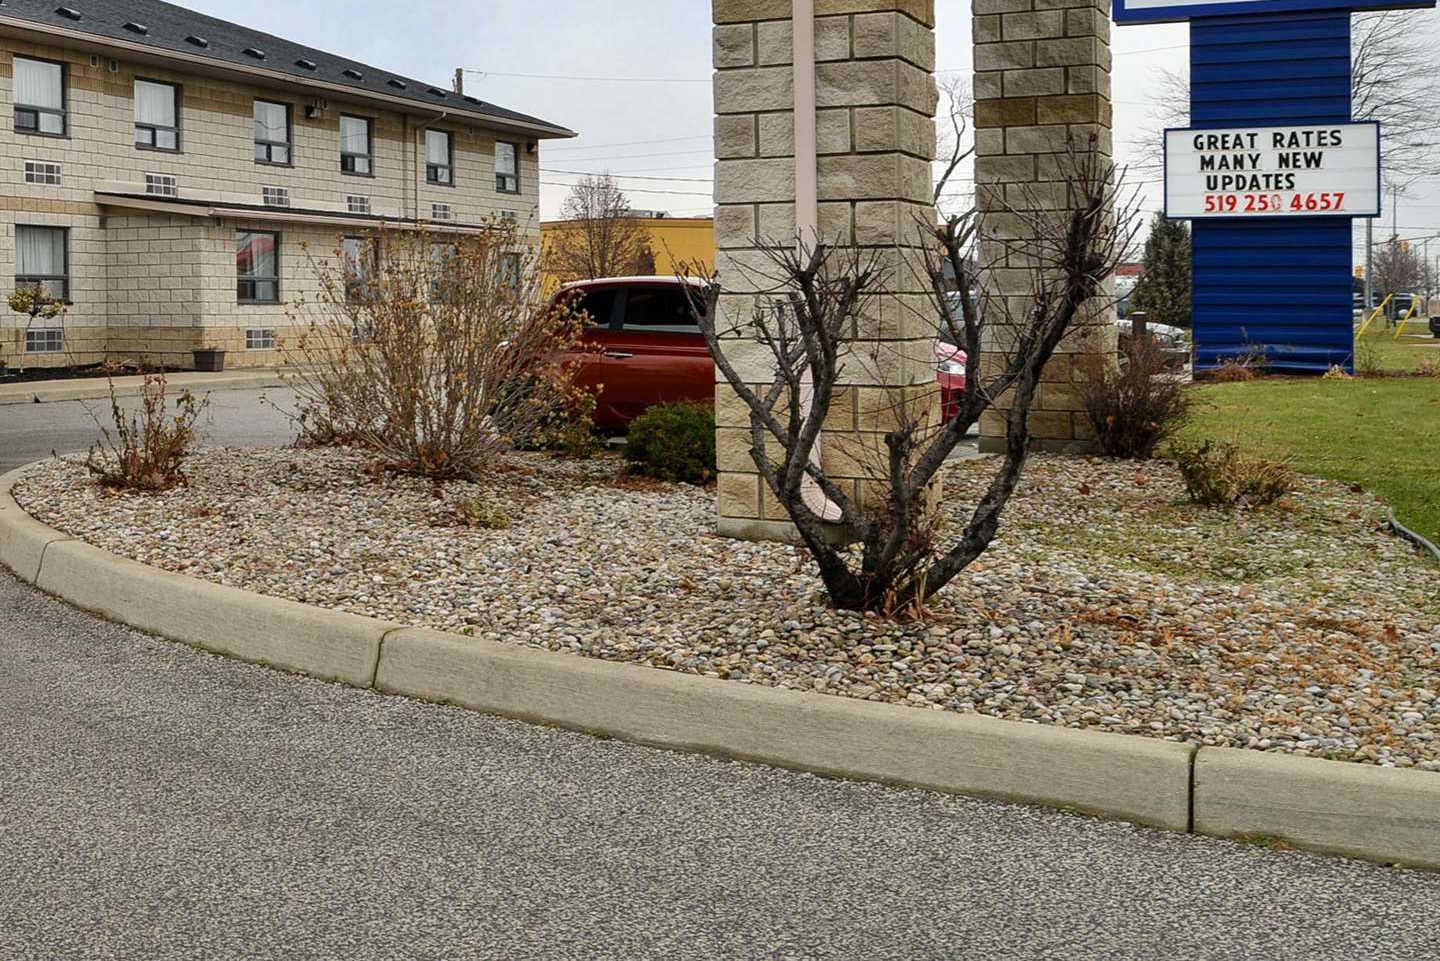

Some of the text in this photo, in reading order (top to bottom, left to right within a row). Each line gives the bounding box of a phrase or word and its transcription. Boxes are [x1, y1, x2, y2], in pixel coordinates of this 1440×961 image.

[1193, 130, 1343, 150] GREAT RATES
[1200, 151, 1324, 171] MANY NEW
[1206, 173, 1296, 191] UPDATES
[1205, 194, 1237, 212] 519
[1290, 192, 1345, 211] 4657
